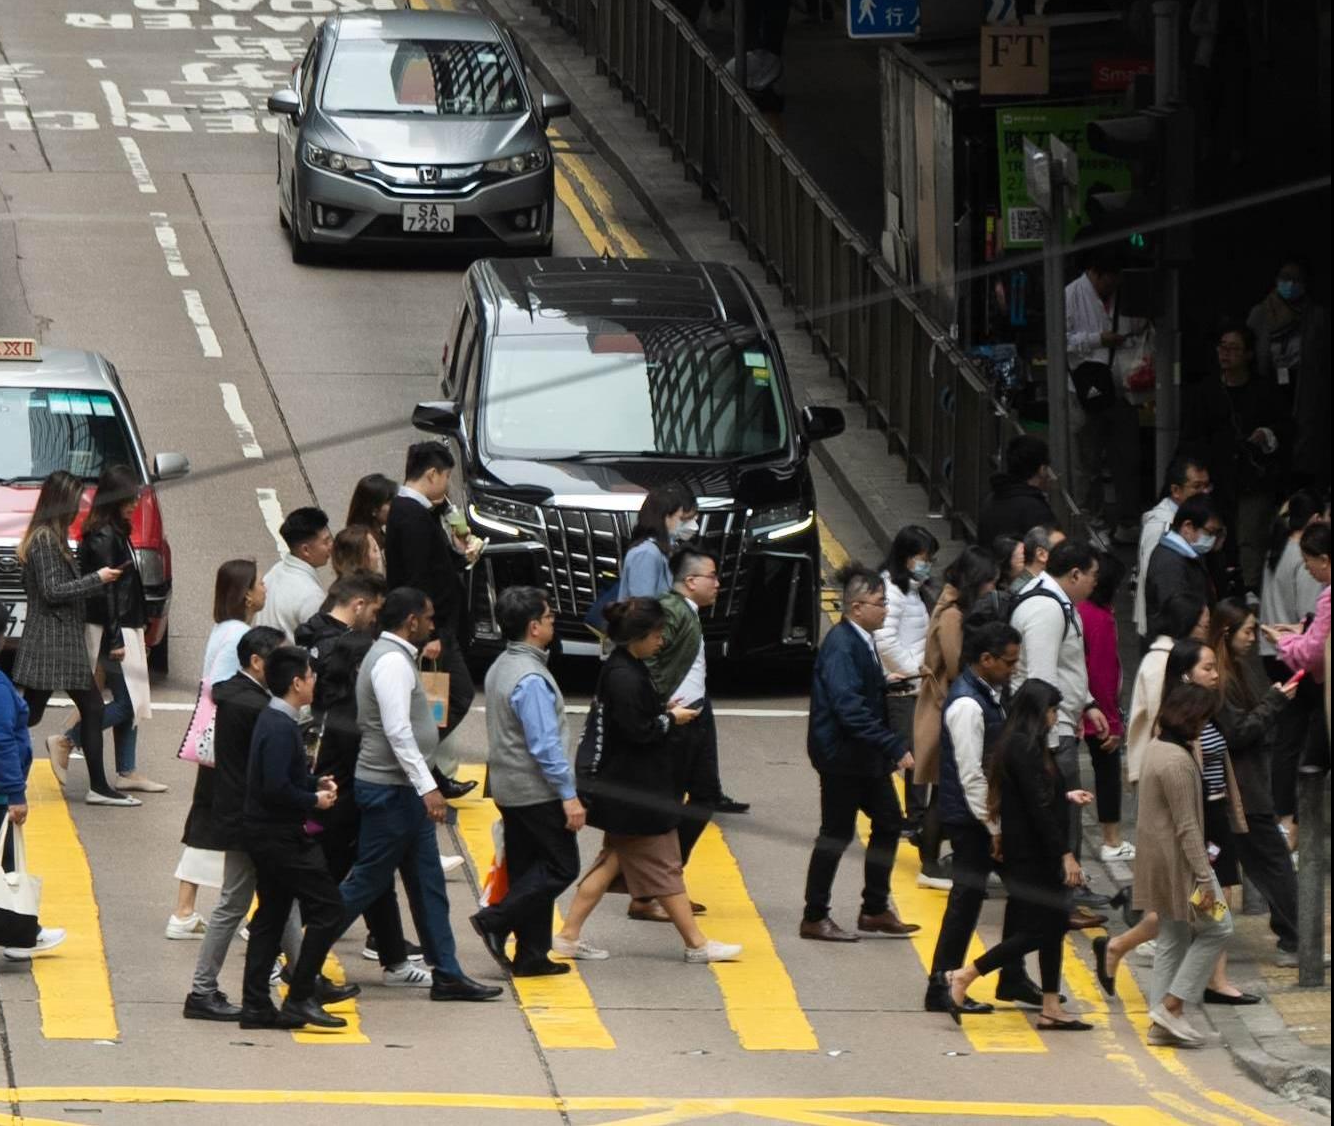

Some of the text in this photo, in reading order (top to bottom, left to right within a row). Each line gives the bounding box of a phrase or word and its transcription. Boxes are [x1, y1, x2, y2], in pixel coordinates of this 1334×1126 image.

[988, 34, 1045, 68] FT
[418, 204, 440, 218] SA
[406, 218, 451, 234] 7220
